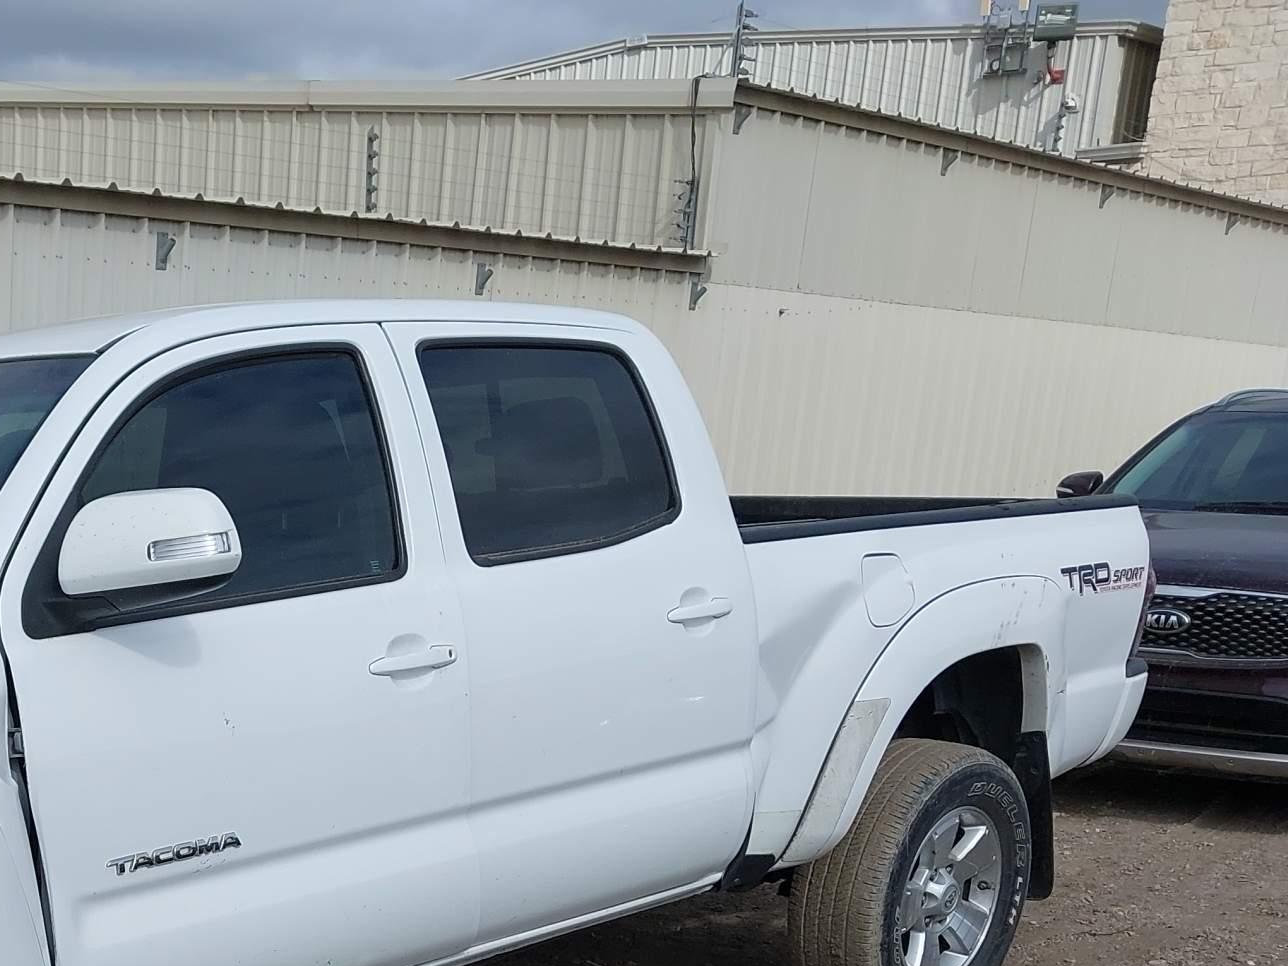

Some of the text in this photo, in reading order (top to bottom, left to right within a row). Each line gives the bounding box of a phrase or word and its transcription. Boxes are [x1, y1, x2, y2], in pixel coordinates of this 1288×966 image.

[1060, 562, 1111, 596] TRD
[1112, 566, 1144, 583] SPORT
[1146, 613, 1179, 628] KIA
[105, 831, 242, 876] TACOMA
